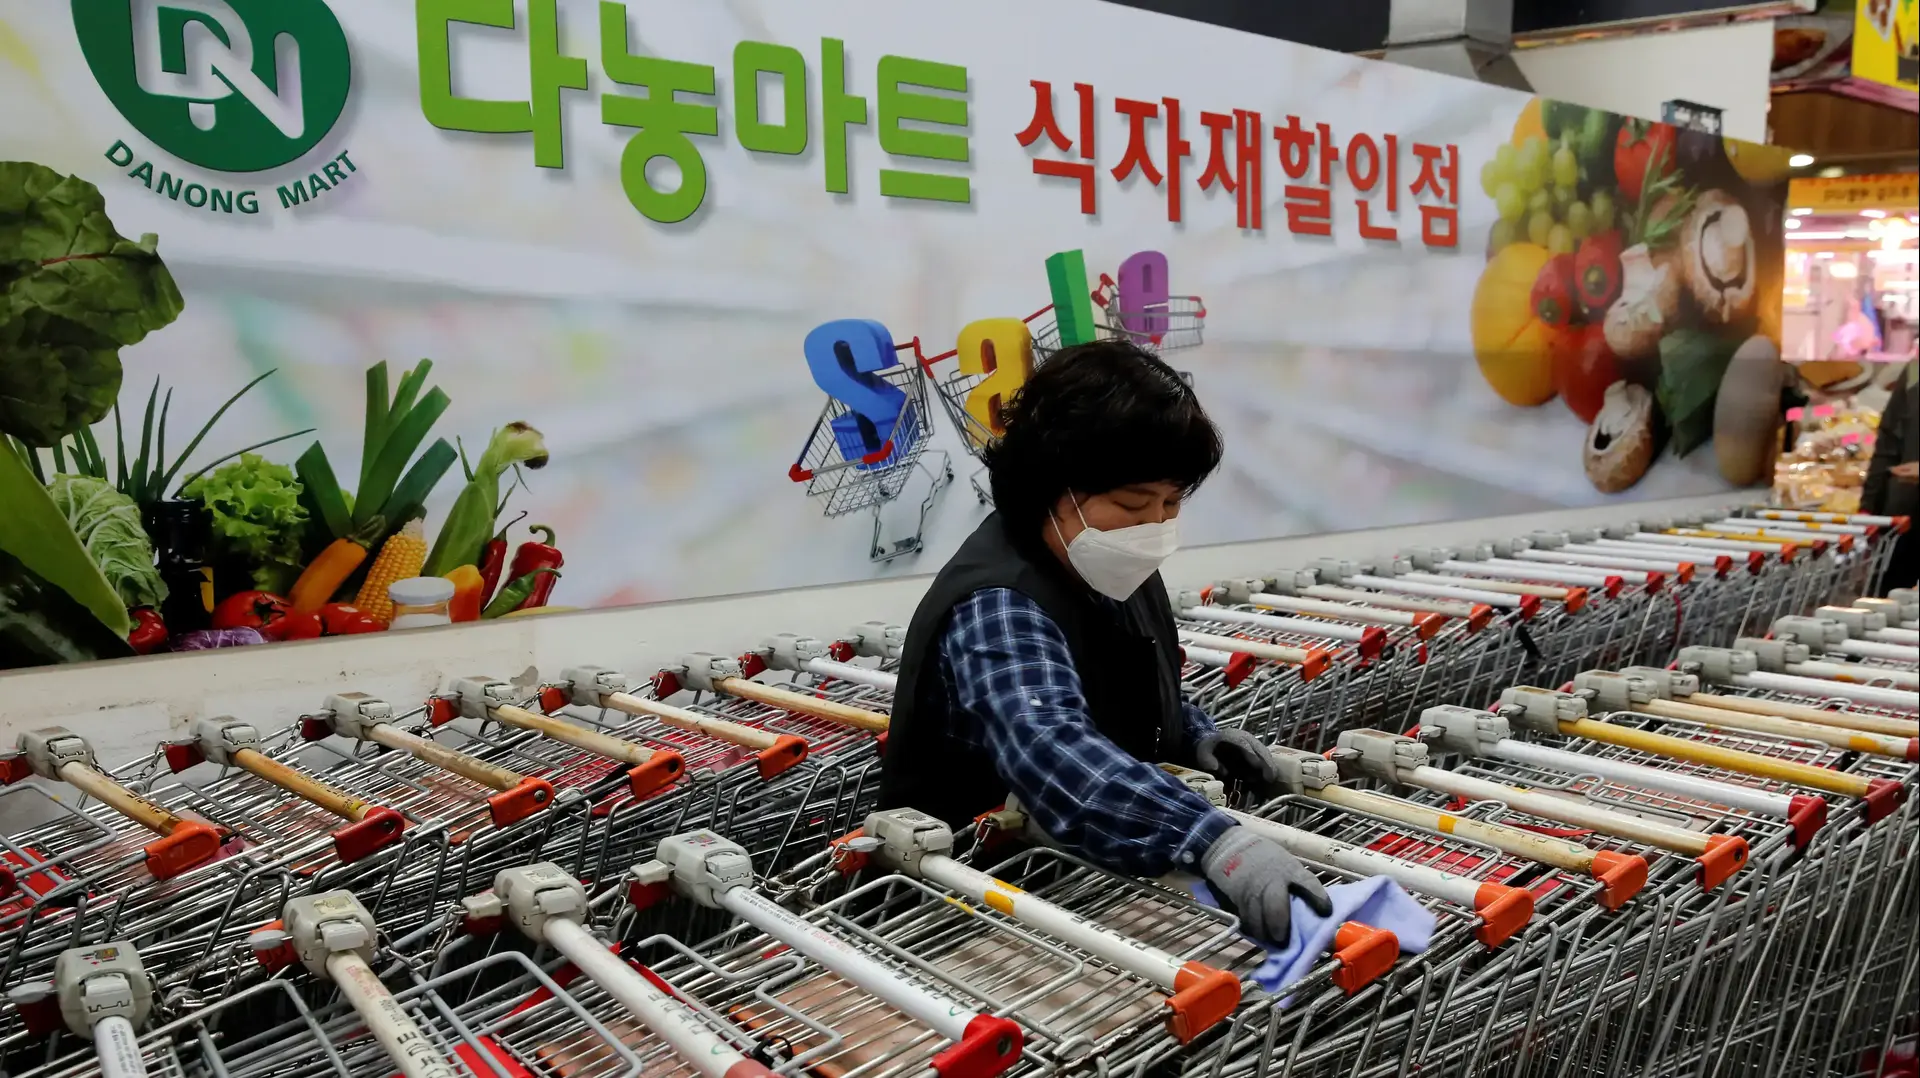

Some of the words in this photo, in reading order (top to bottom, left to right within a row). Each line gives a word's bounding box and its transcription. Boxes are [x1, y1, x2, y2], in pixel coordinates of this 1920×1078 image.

[104, 139, 259, 214] DANONG
[276, 149, 358, 209] MART
[415, 0, 970, 223] 다농마트
[1014, 79, 1460, 247] 식자재할인점
